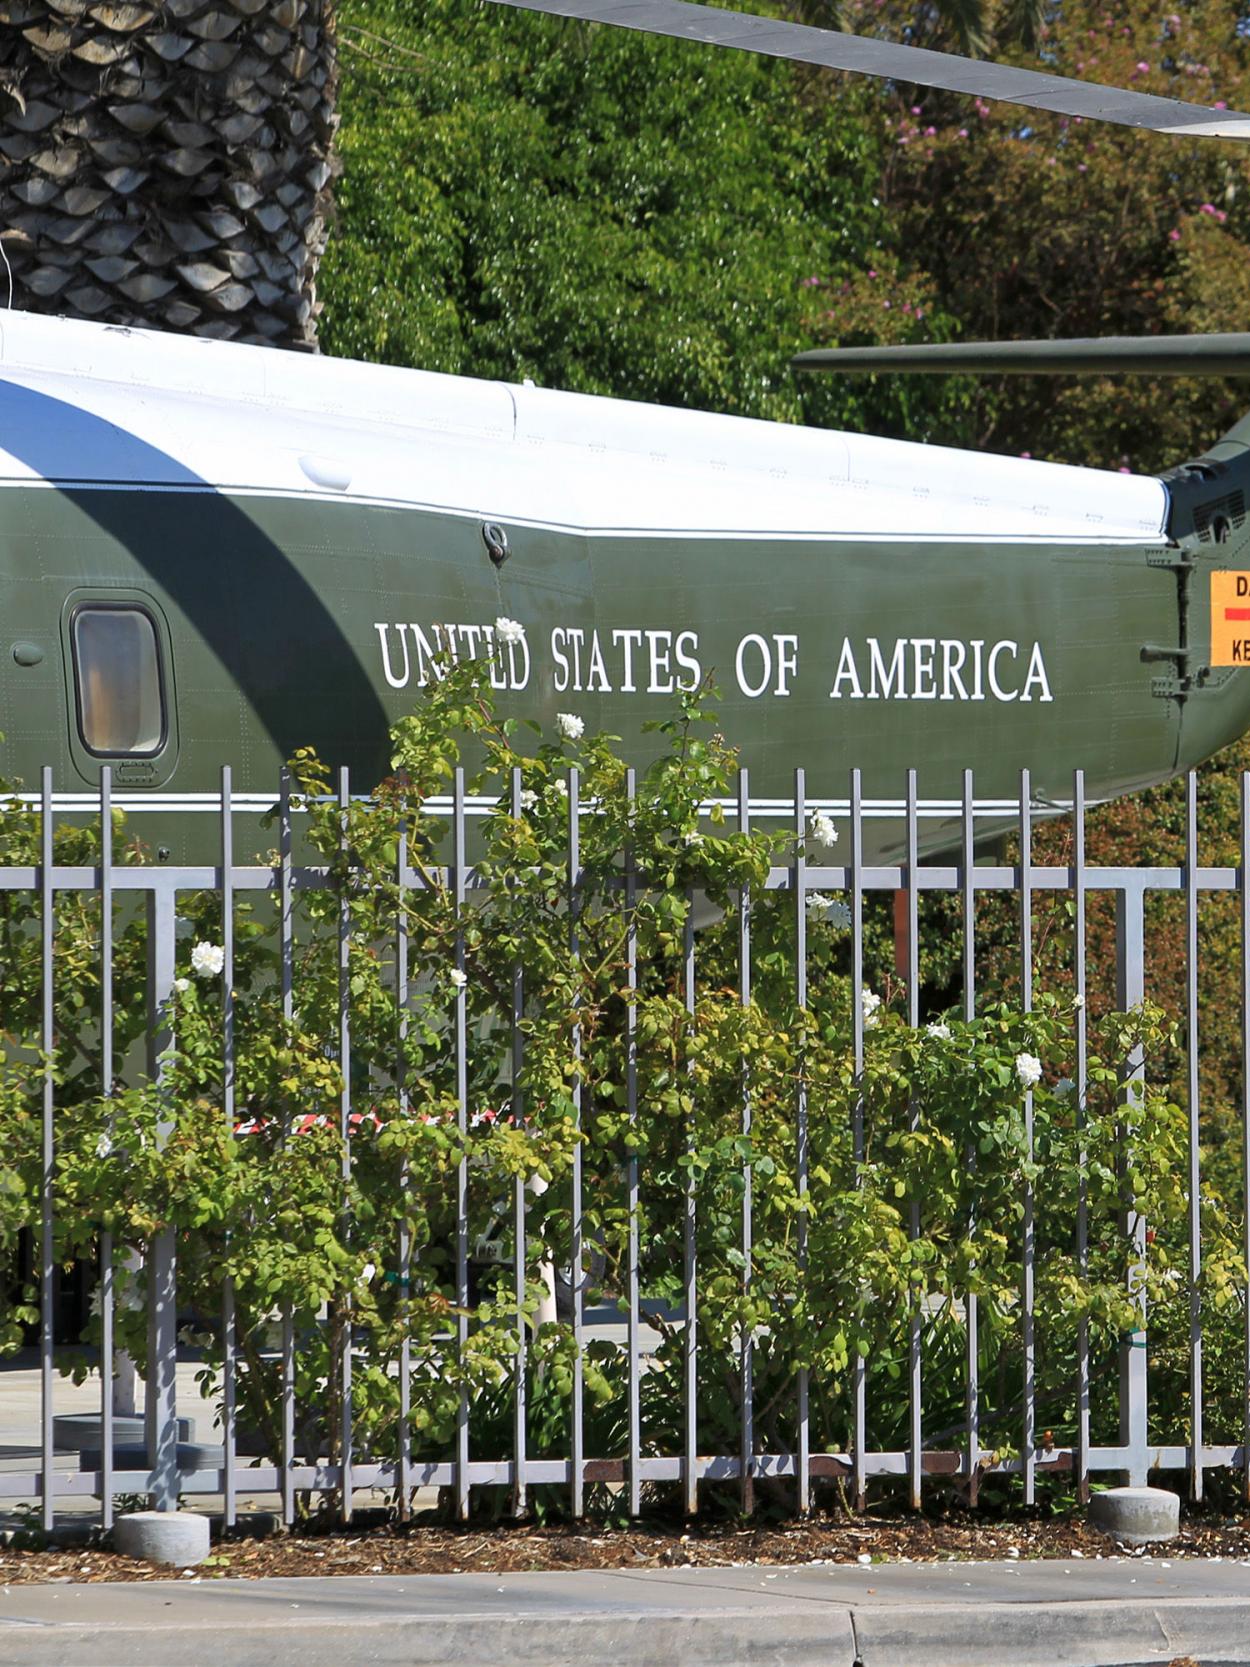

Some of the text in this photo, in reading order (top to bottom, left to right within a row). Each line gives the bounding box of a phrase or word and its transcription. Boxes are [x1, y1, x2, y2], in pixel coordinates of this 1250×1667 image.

[374, 622, 1054, 702] UNITED STATES OF AMERICA
